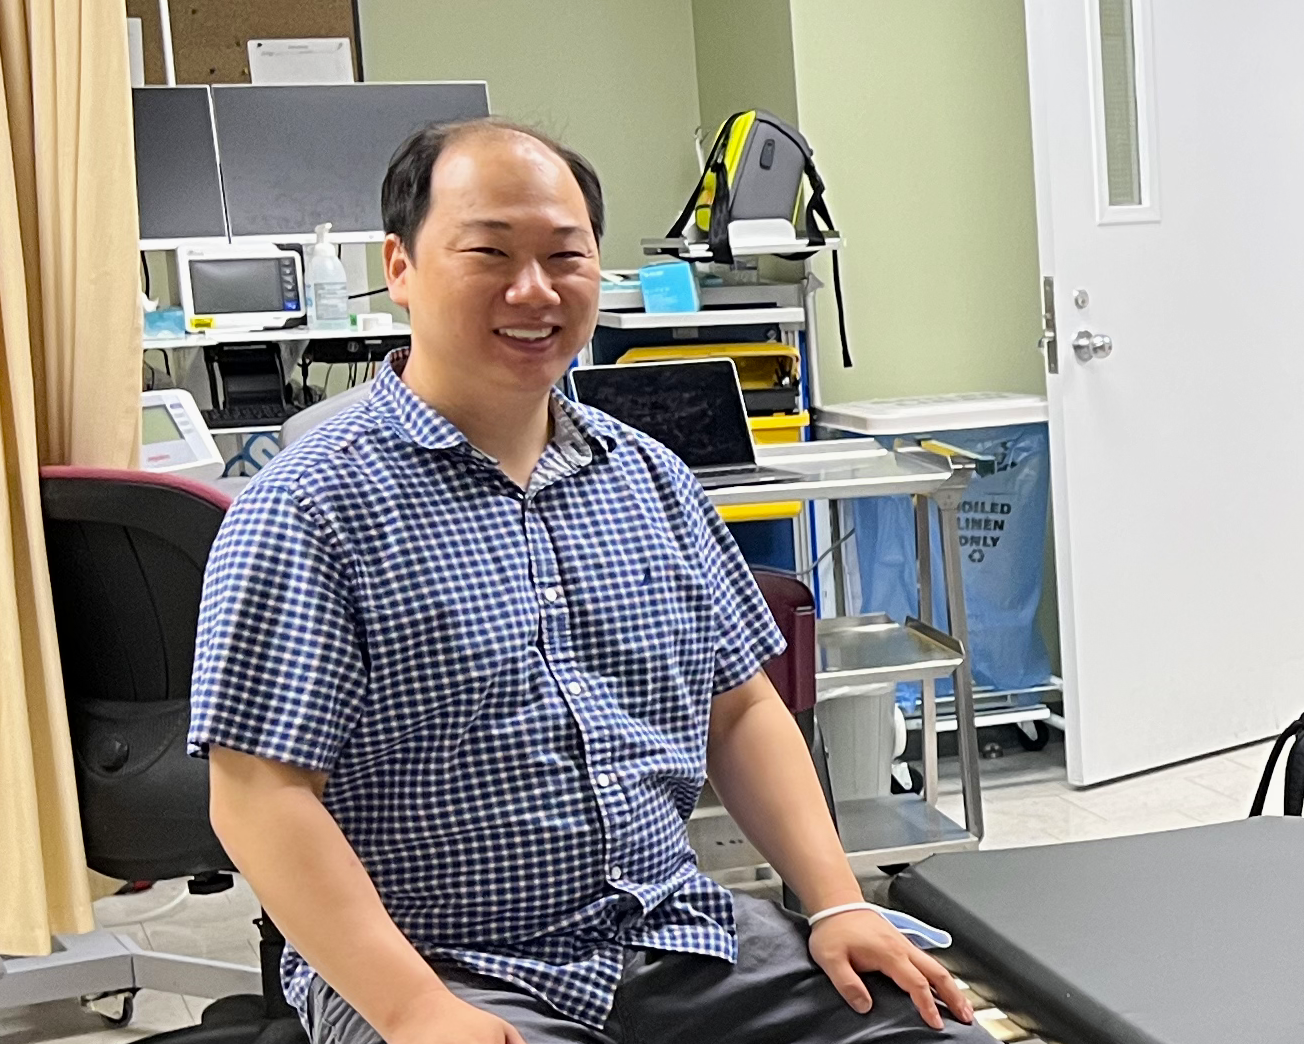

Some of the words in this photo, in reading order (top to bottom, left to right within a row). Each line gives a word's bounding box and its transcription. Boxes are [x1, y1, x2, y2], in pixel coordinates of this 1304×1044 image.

[957, 500, 1012, 514] OILED
[956, 517, 1005, 531] LINEN
[958, 535, 1001, 547] ONLY
